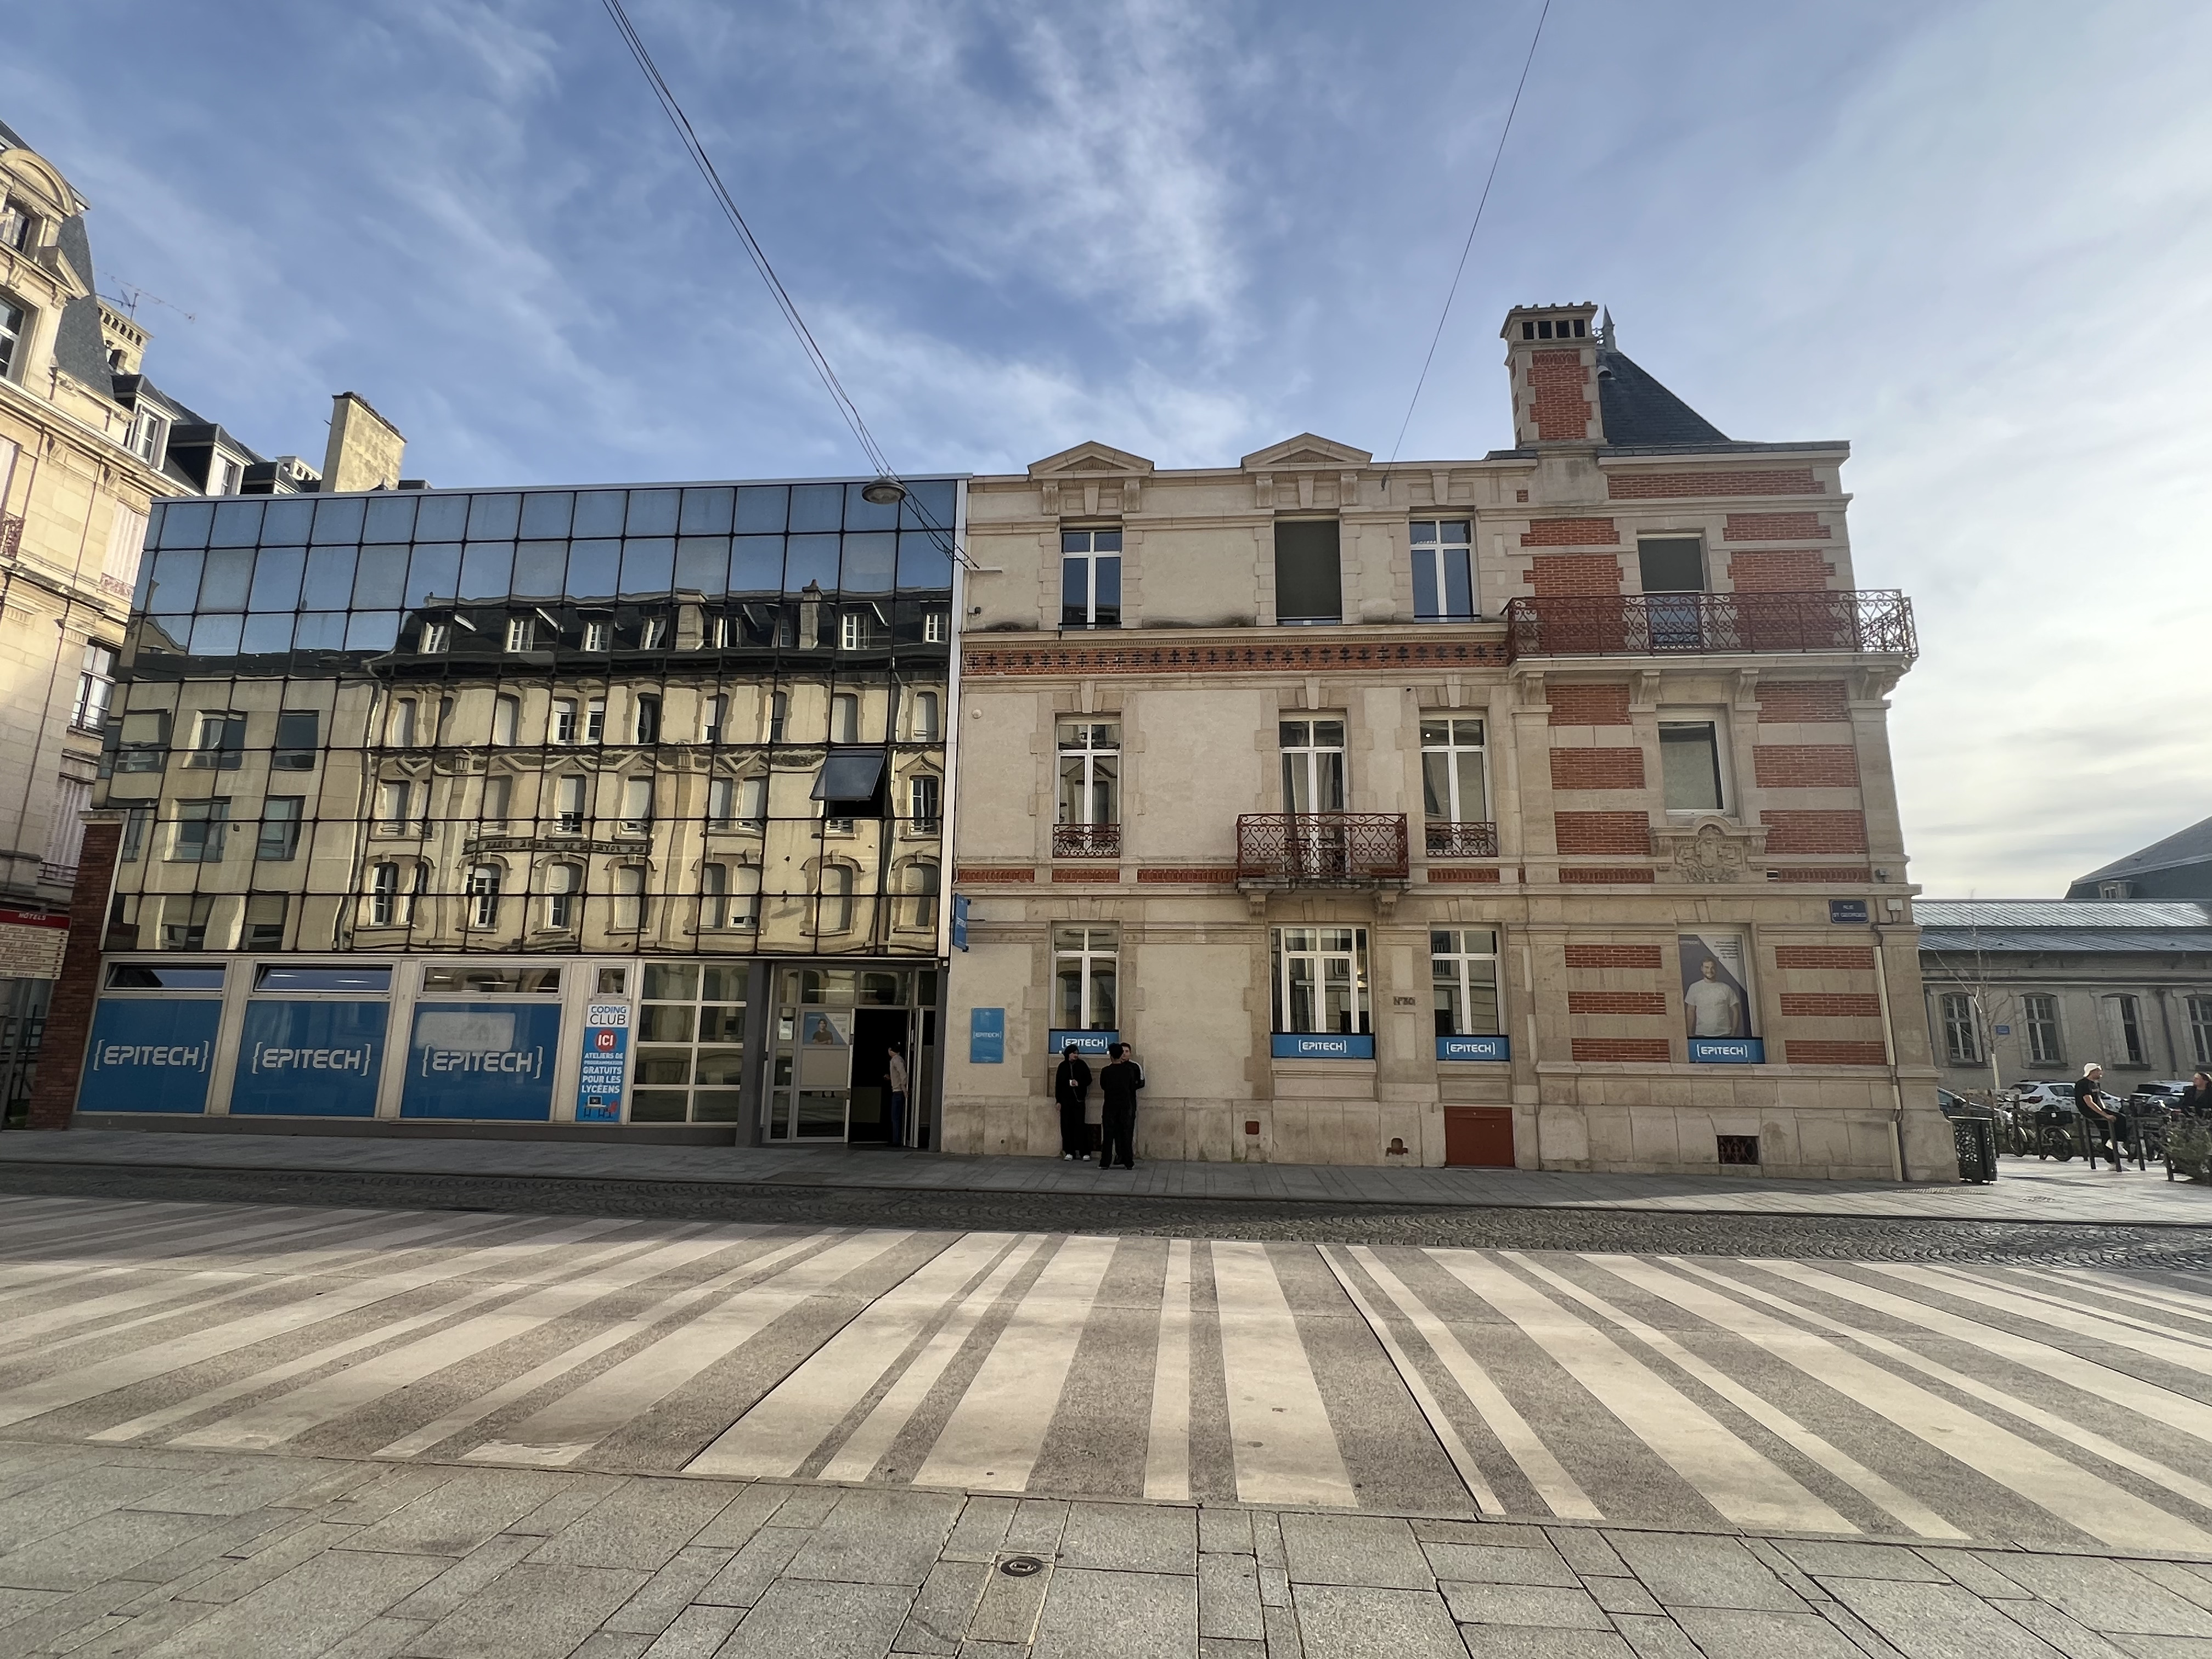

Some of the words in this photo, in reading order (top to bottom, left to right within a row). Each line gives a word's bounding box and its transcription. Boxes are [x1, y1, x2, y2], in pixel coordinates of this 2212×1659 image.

[591, 1006, 627, 1014] CODING
[590, 1014, 626, 1025] CLUB
[598, 1034, 614, 1046] ICI
[583, 1066, 622, 1075] GRATUITS
[582, 1075, 604, 1084] POUR
[606, 1075, 621, 1084] LES
[582, 1083, 620, 1093] LYCÉENS
